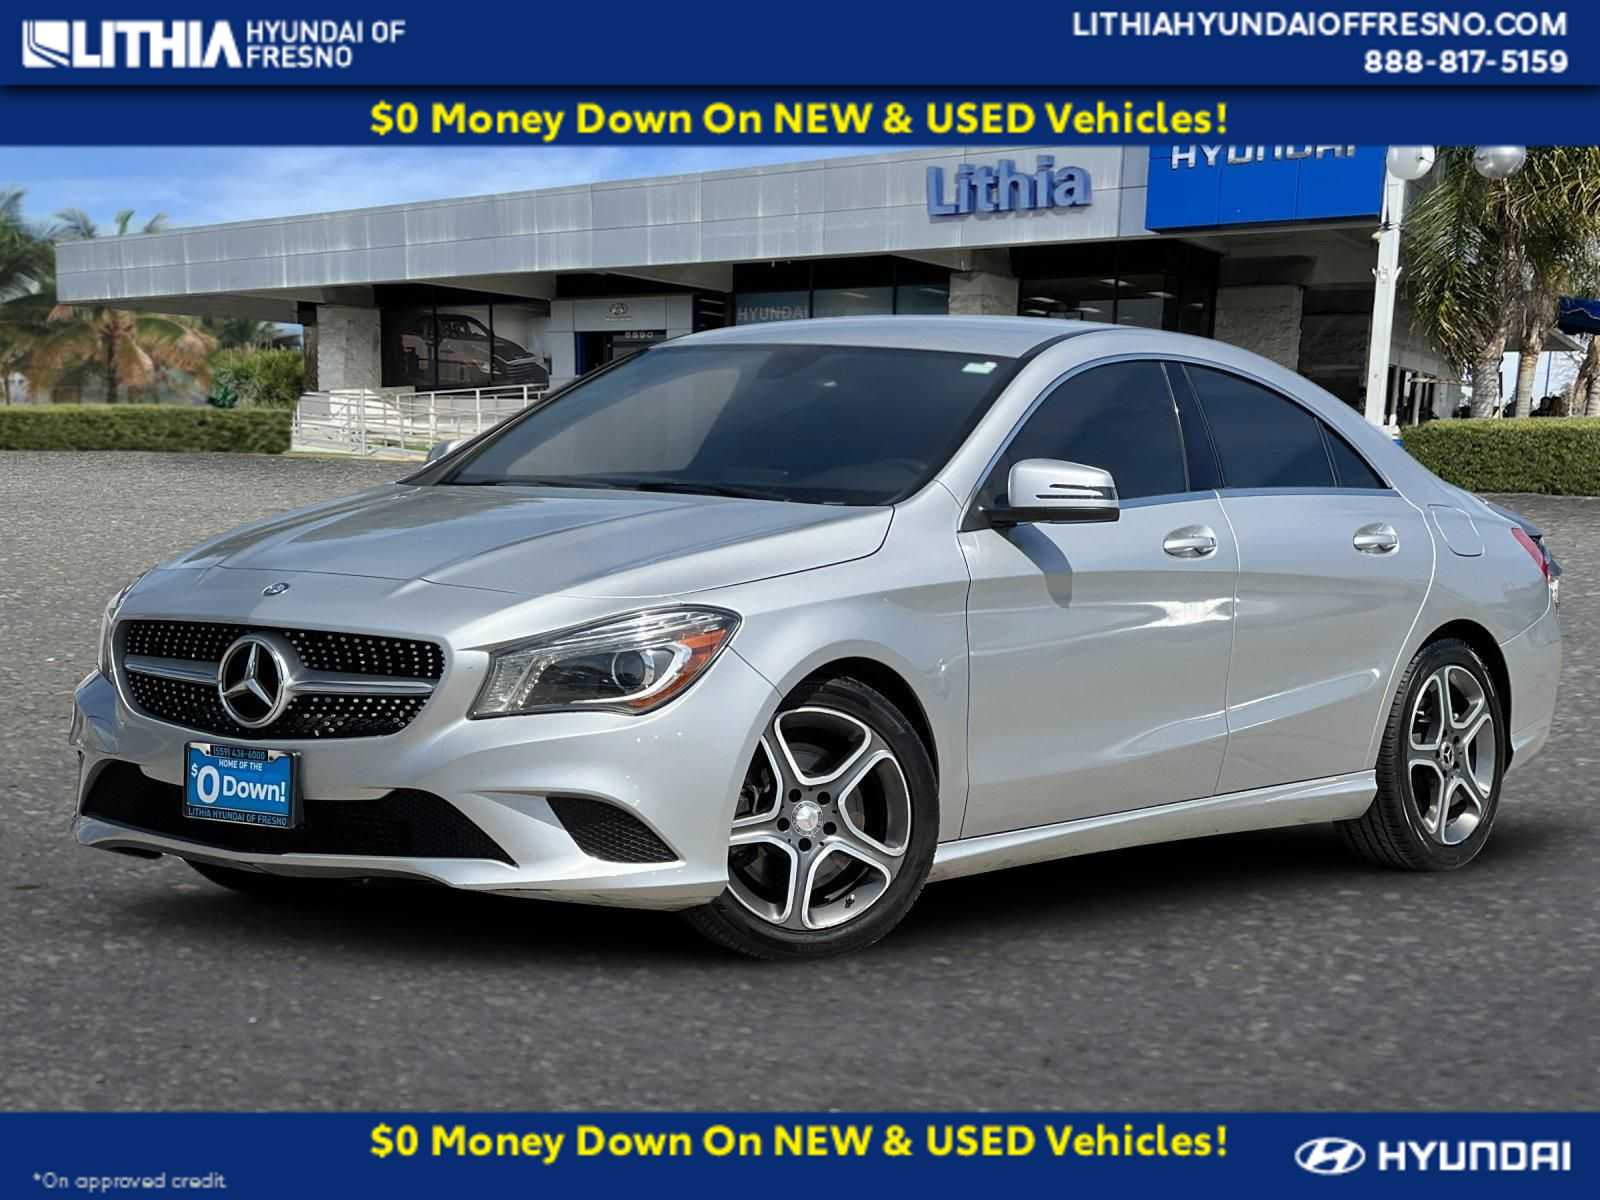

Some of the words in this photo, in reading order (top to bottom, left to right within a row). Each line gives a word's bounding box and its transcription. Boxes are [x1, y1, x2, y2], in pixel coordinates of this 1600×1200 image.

[926, 154, 1092, 217] Lithia
[737, 305, 809, 321] HYUNDAI
[218, 759, 238, 769] HOME
[239, 761, 248, 769] OF
[249, 761, 263, 772] THE
[223, 775, 286, 803] Down!
[188, 807, 212, 818] LITHIA
[213, 810, 245, 822] HYUNDAI
[246, 813, 256, 823] OF
[257, 815, 287, 826] FRESNO
